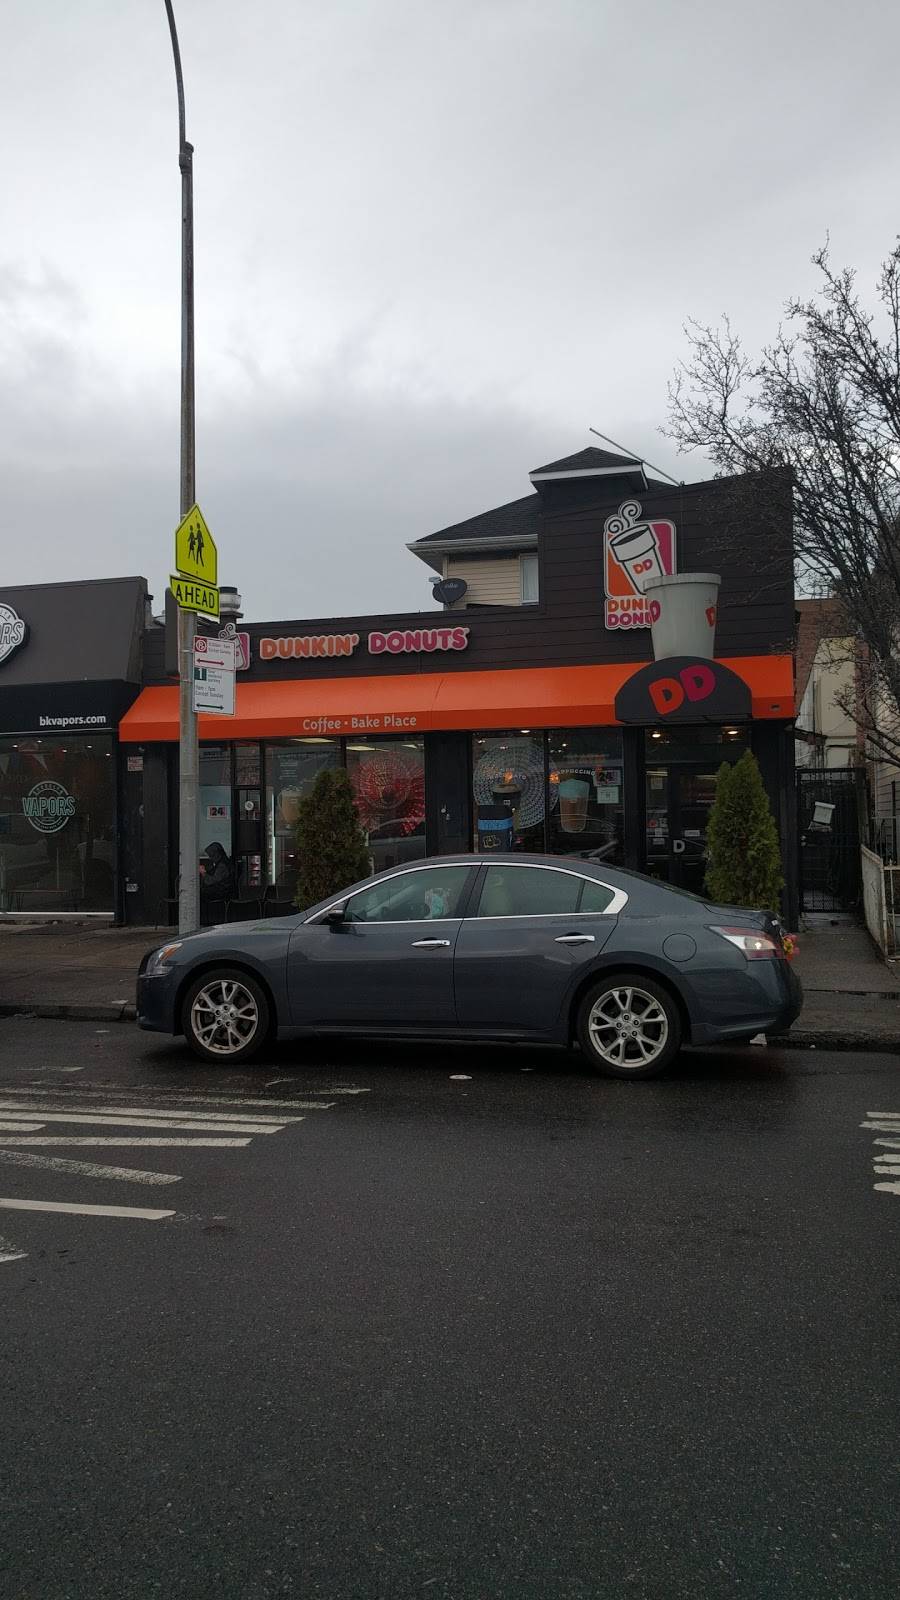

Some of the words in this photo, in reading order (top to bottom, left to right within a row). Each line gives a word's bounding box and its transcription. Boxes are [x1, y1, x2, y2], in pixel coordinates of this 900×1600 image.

[632, 558, 654, 574] DD
[176, 584, 215, 609] AHEAD
[0, 621, 24, 645] RS
[261, 634, 358, 659] DUNKIN'
[369, 628, 467, 653] DONUTS
[649, 664, 716, 715] DD
[39, 716, 107, 727] bkvapors.com
[302, 717, 341, 733] Coffee
[351, 715, 380, 729] Bake
[383, 715, 417, 727] Place
[22, 796, 76, 817] VAPORS
